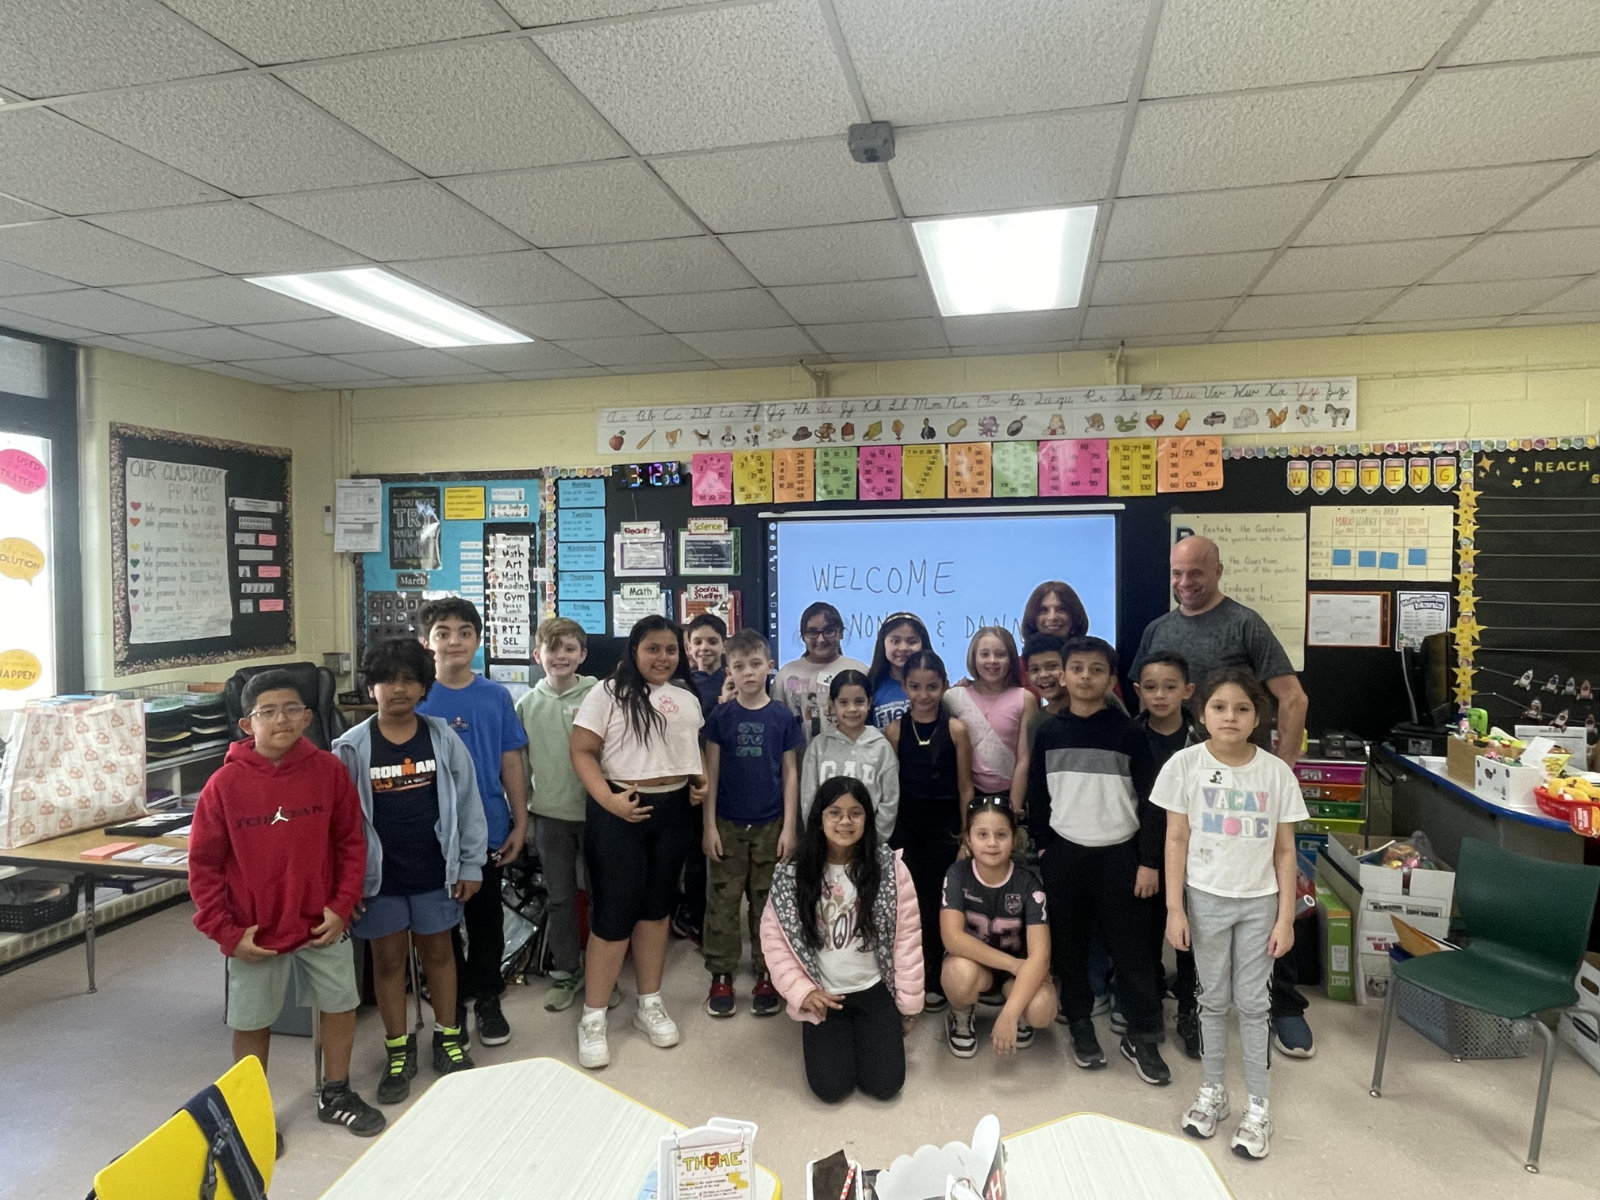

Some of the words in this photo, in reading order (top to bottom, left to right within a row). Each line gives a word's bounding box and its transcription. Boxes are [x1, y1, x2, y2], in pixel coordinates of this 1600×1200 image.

[690, 406, 712, 420] Dd
[914, 396, 944, 411] Mm
[946, 395, 970, 410] Nn
[1534, 460, 1590, 473] REACH
[130, 460, 157, 480] OUR
[162, 463, 223, 484] CLASSROOM
[1290, 467, 1451, 485] WRITING
[168, 483, 214, 502] PRMIS
[400, 498, 414, 507] YOU
[393, 508, 436, 528] TRY
[693, 521, 723, 532] Science
[1202, 524, 1232, 535] Restate
[1240, 524, 1251, 533] the
[1255, 524, 1286, 534] Question
[394, 539, 433, 559] KNO
[502, 550, 525, 558] Math
[505, 560, 522, 569] Art
[1229, 556, 1240, 565] the
[1244, 556, 1278, 566] Question
[400, 576, 426, 586] March
[502, 571, 524, 581] Math
[811, 558, 956, 597] WELCOME
[498, 582, 529, 591] Reading
[629, 586, 653, 596] Math
[694, 585, 720, 593] Social
[1223, 583, 1256, 593] Evidence
[504, 593, 526, 603] Gym
[694, 592, 723, 600] Studies
[502, 625, 522, 635] RTI
[503, 636, 519, 646] SEL
[1202, 788, 1269, 813] VACAY
[1202, 812, 1269, 839] MODE
[1421, 910, 1440, 918] PAPER
[682, 1152, 743, 1172] THEME
